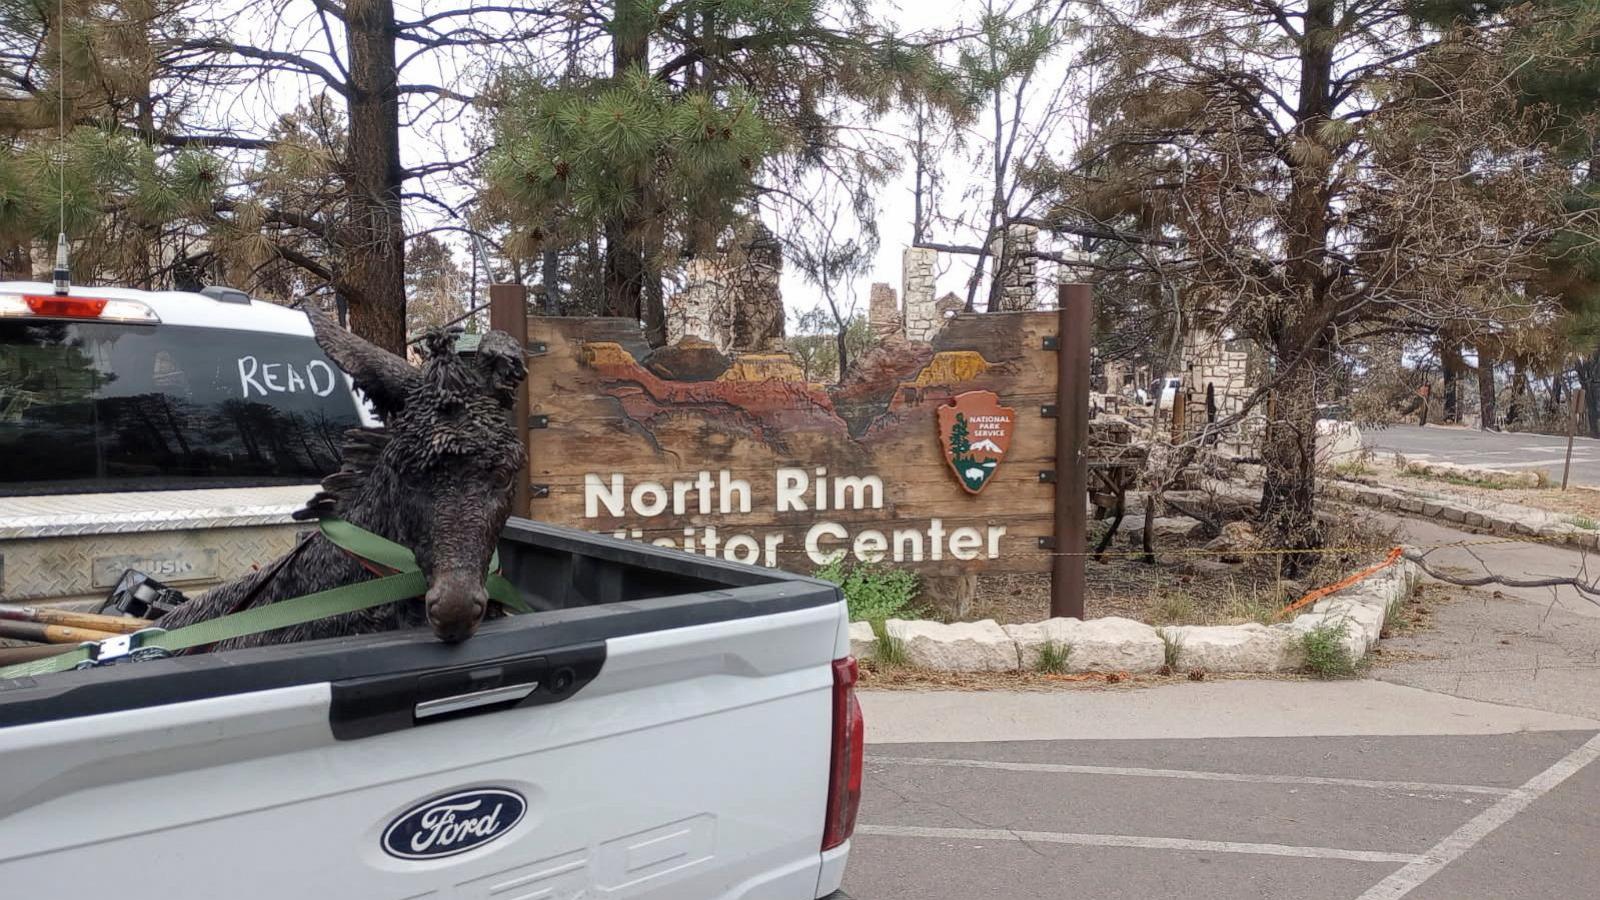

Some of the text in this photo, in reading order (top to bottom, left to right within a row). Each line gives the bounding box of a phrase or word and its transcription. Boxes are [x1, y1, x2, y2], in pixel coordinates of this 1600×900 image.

[238, 355, 336, 398] READ
[584, 466, 884, 518] North Rim
[588, 518, 1007, 568] itor Center
[411, 799, 503, 851] Ford
